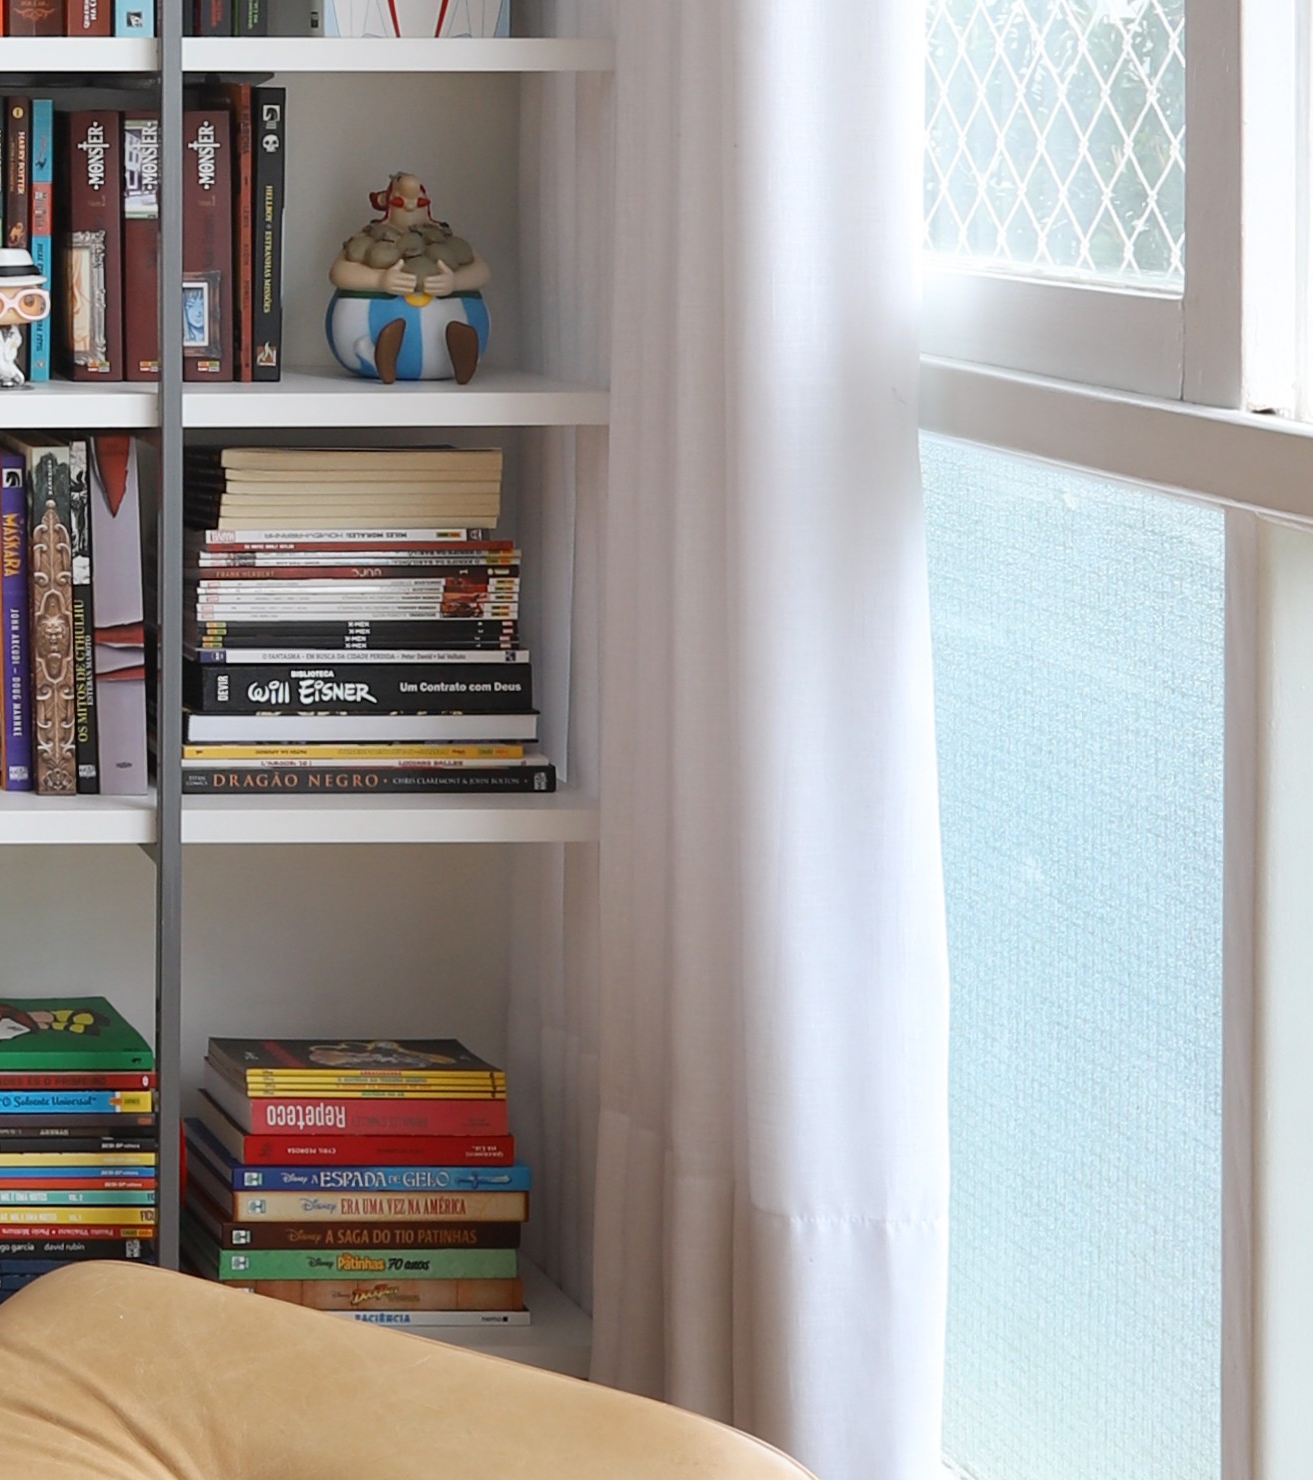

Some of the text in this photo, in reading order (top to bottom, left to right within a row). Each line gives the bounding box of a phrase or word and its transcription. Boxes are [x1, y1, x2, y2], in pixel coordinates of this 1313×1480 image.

[78, 124, 111, 187] MONSTER
[188, 124, 221, 187] MONSTER
[291, 670, 334, 678] BIBLIOTECA
[217, 675, 229, 701] DEVIR
[247, 681, 290, 704] Will
[400, 681, 522, 692] Um Contrato com Deus
[213, 770, 379, 788] DRAGÃO NEGRO
[266, 1105, 346, 1130] Repeteco
[320, 1171, 387, 1188] ESPADA
[403, 1171, 450, 1188] GELO
[325, 1229, 478, 1244] A SAGA DO TIO PATINHAS
[336, 1254, 430, 1271] Patinhas 70 anos
